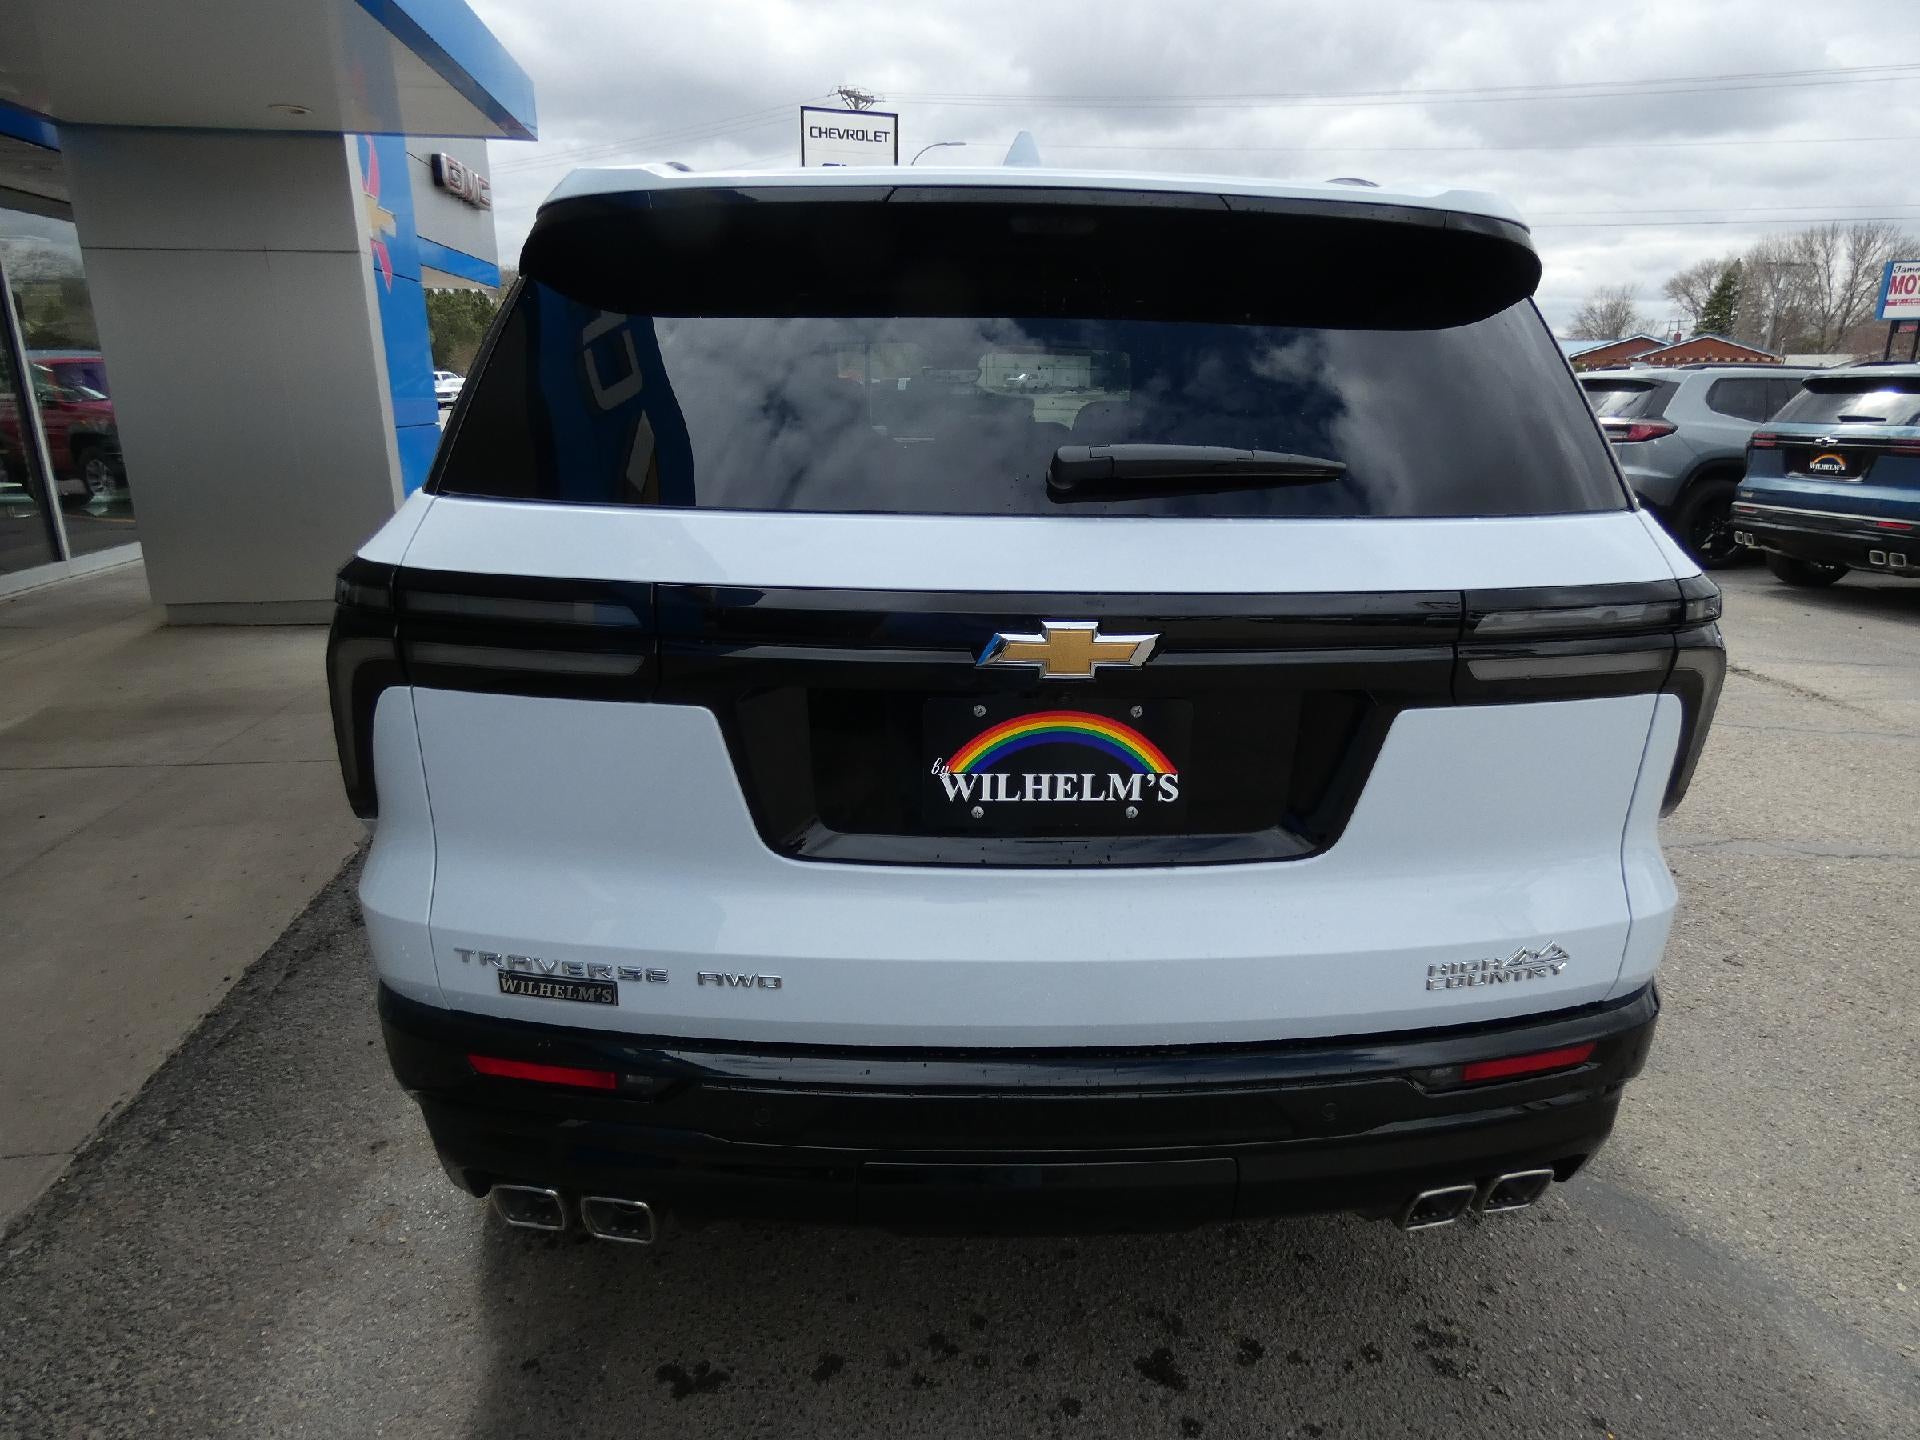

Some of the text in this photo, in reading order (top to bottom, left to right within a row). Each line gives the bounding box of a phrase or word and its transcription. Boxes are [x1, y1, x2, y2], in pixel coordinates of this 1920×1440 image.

[809, 125, 891, 143] CHEVROLET
[441, 153, 492, 208] GMC
[1889, 274, 1920, 295] MO
[931, 757, 951, 779] by
[941, 773, 1179, 803] WILHELM'S
[454, 948, 783, 989] TRAVERSE AWD
[1425, 962, 1568, 991] COUNTRY
[1427, 958, 1503, 977] HIGH
[501, 979, 614, 1003] WILHELM'S
